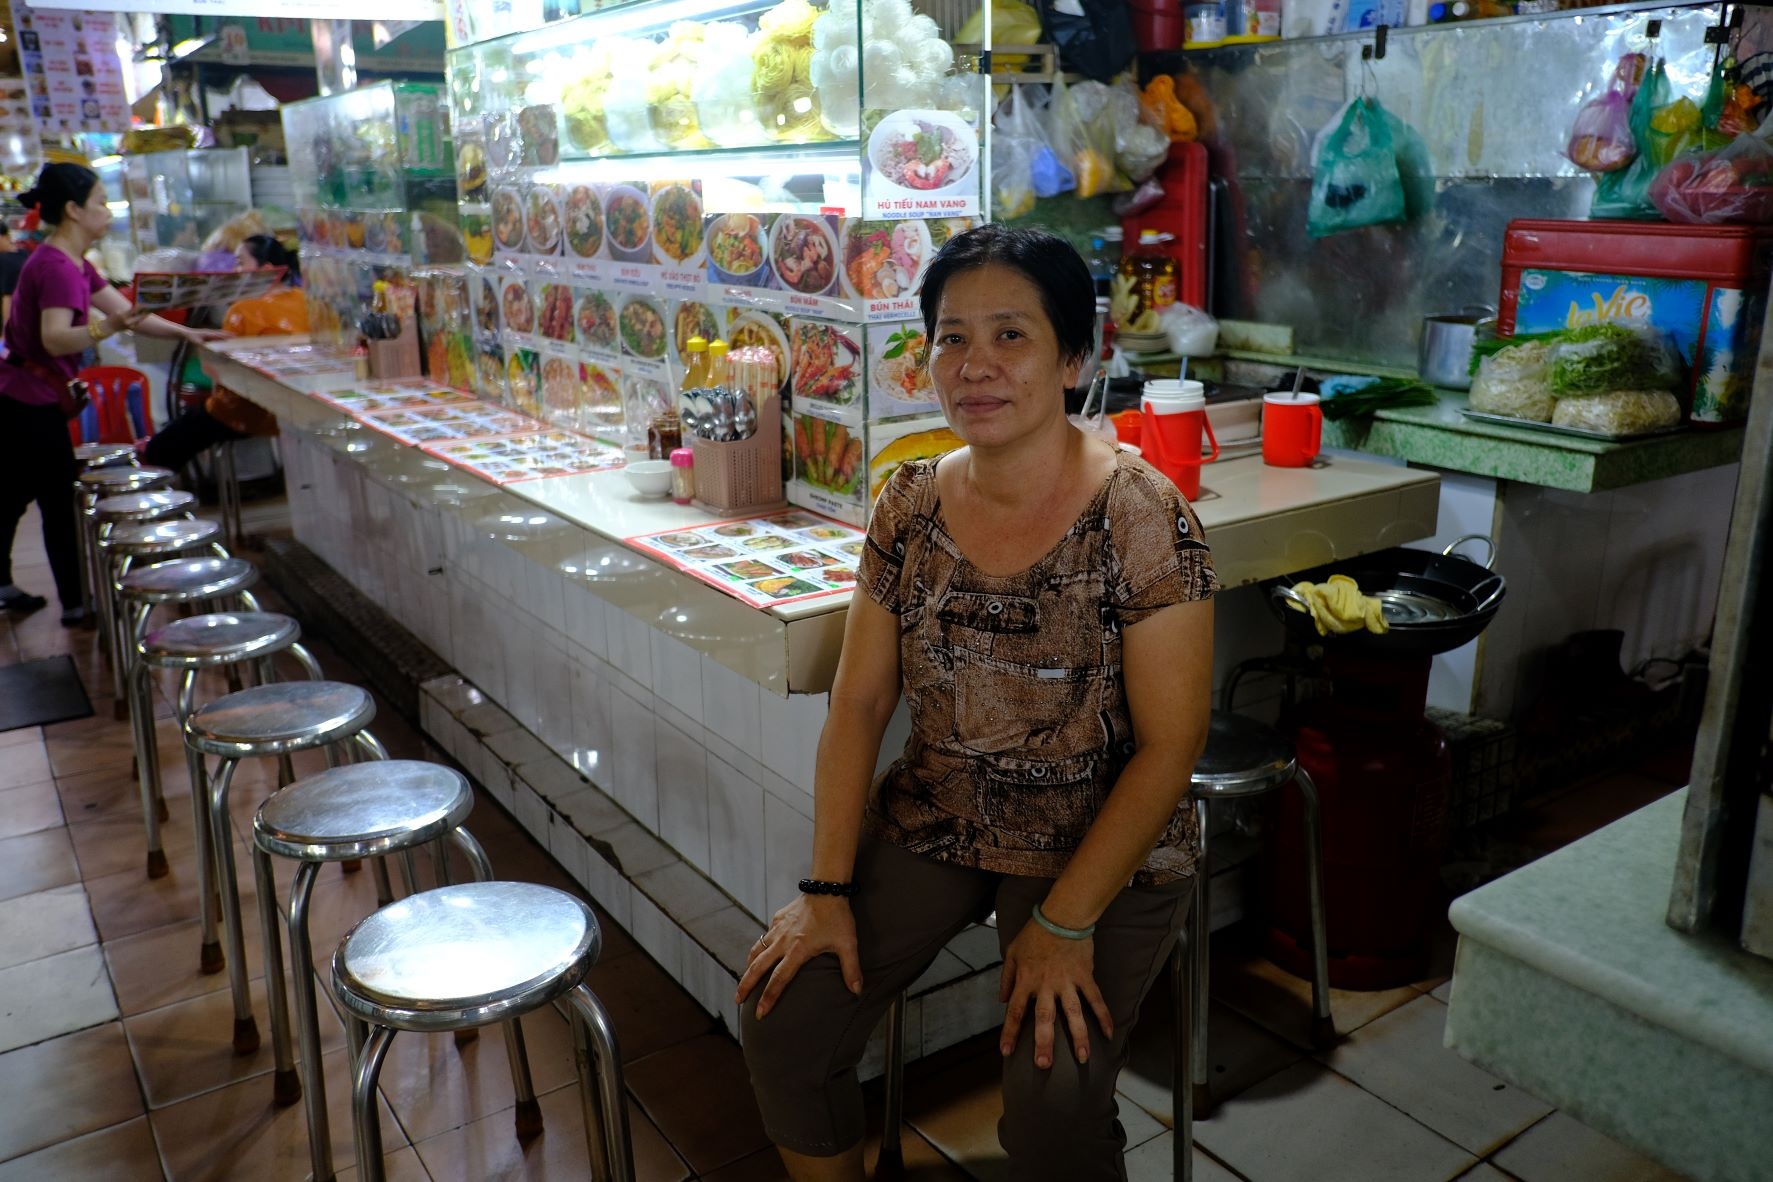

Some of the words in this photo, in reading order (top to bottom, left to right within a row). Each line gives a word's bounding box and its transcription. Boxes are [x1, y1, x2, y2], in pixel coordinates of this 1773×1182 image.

[916, 200, 937, 209] NAM
[940, 200, 966, 208] VANG
[870, 302, 889, 312] BÚN
[892, 299, 913, 310] THÁI
